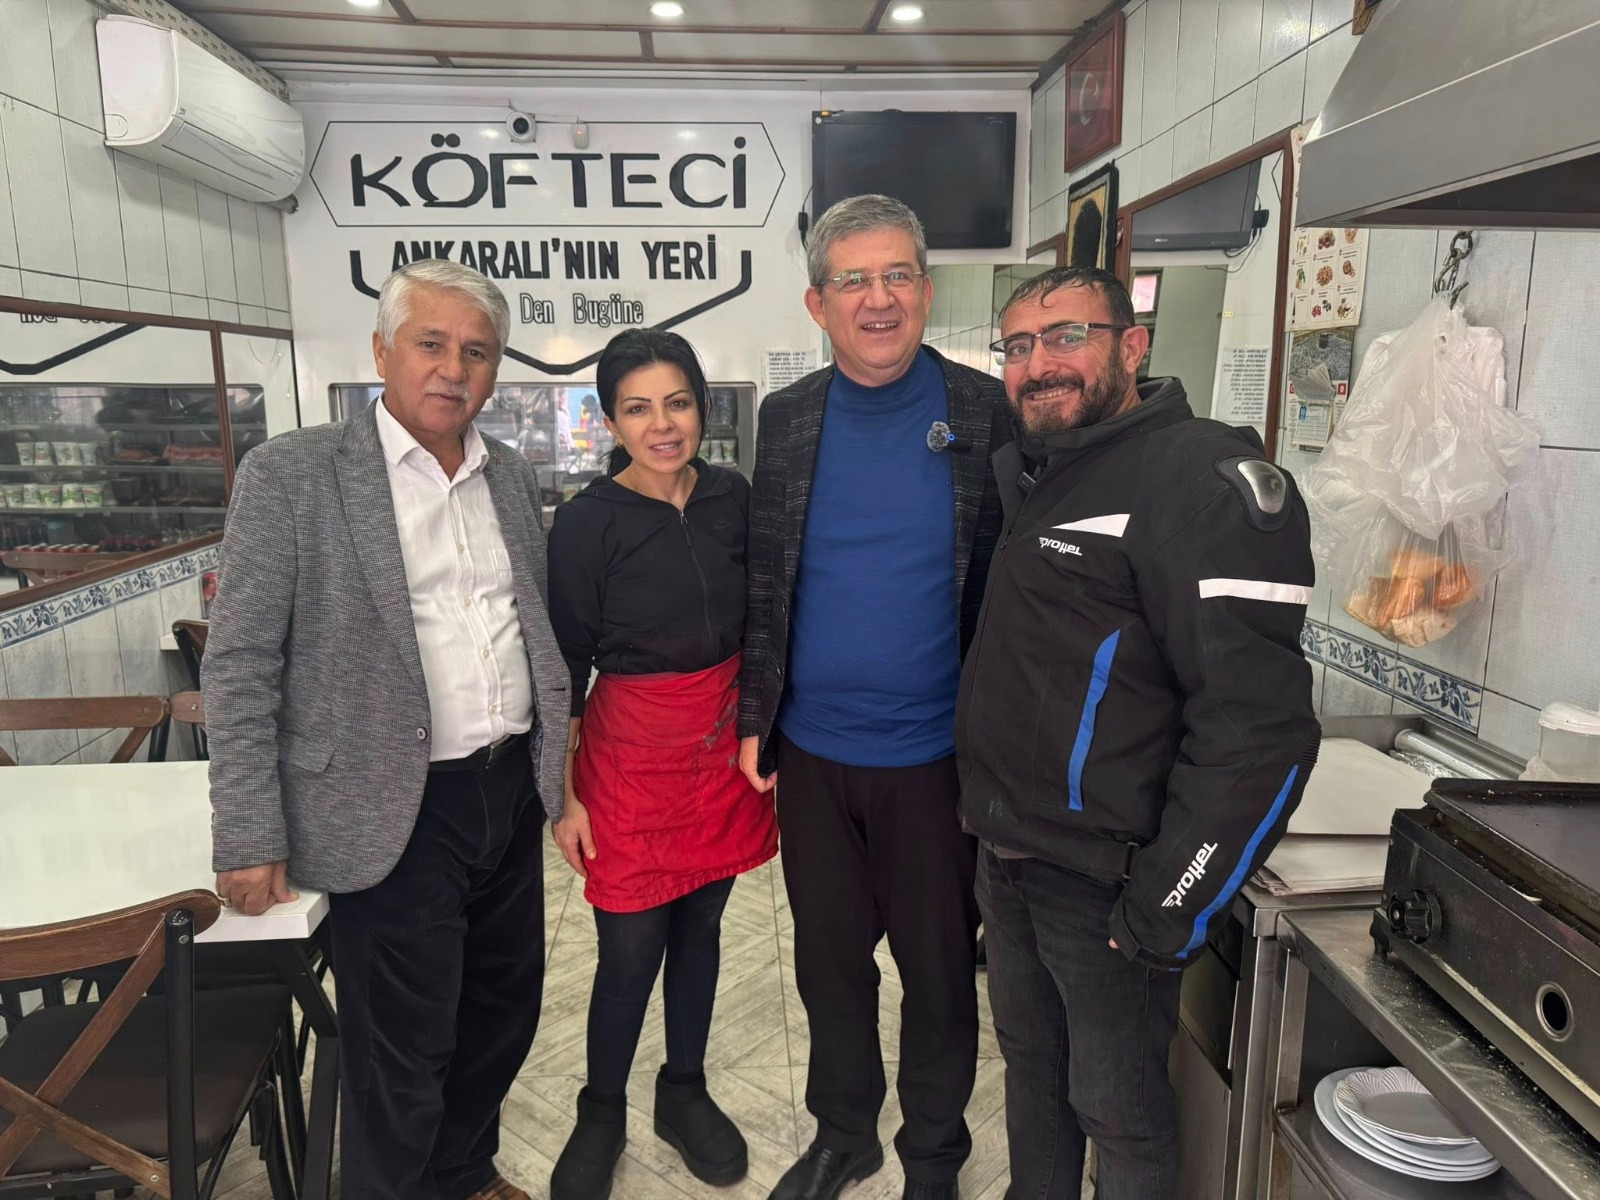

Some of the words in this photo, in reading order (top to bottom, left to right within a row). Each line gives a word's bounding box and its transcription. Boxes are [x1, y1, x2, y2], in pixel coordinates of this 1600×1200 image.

[351, 133, 746, 209] KÖFTECİ
[641, 234, 717, 280] YERİ
[519, 293, 555, 324] Den
[573, 292, 644, 328] Bugüne
